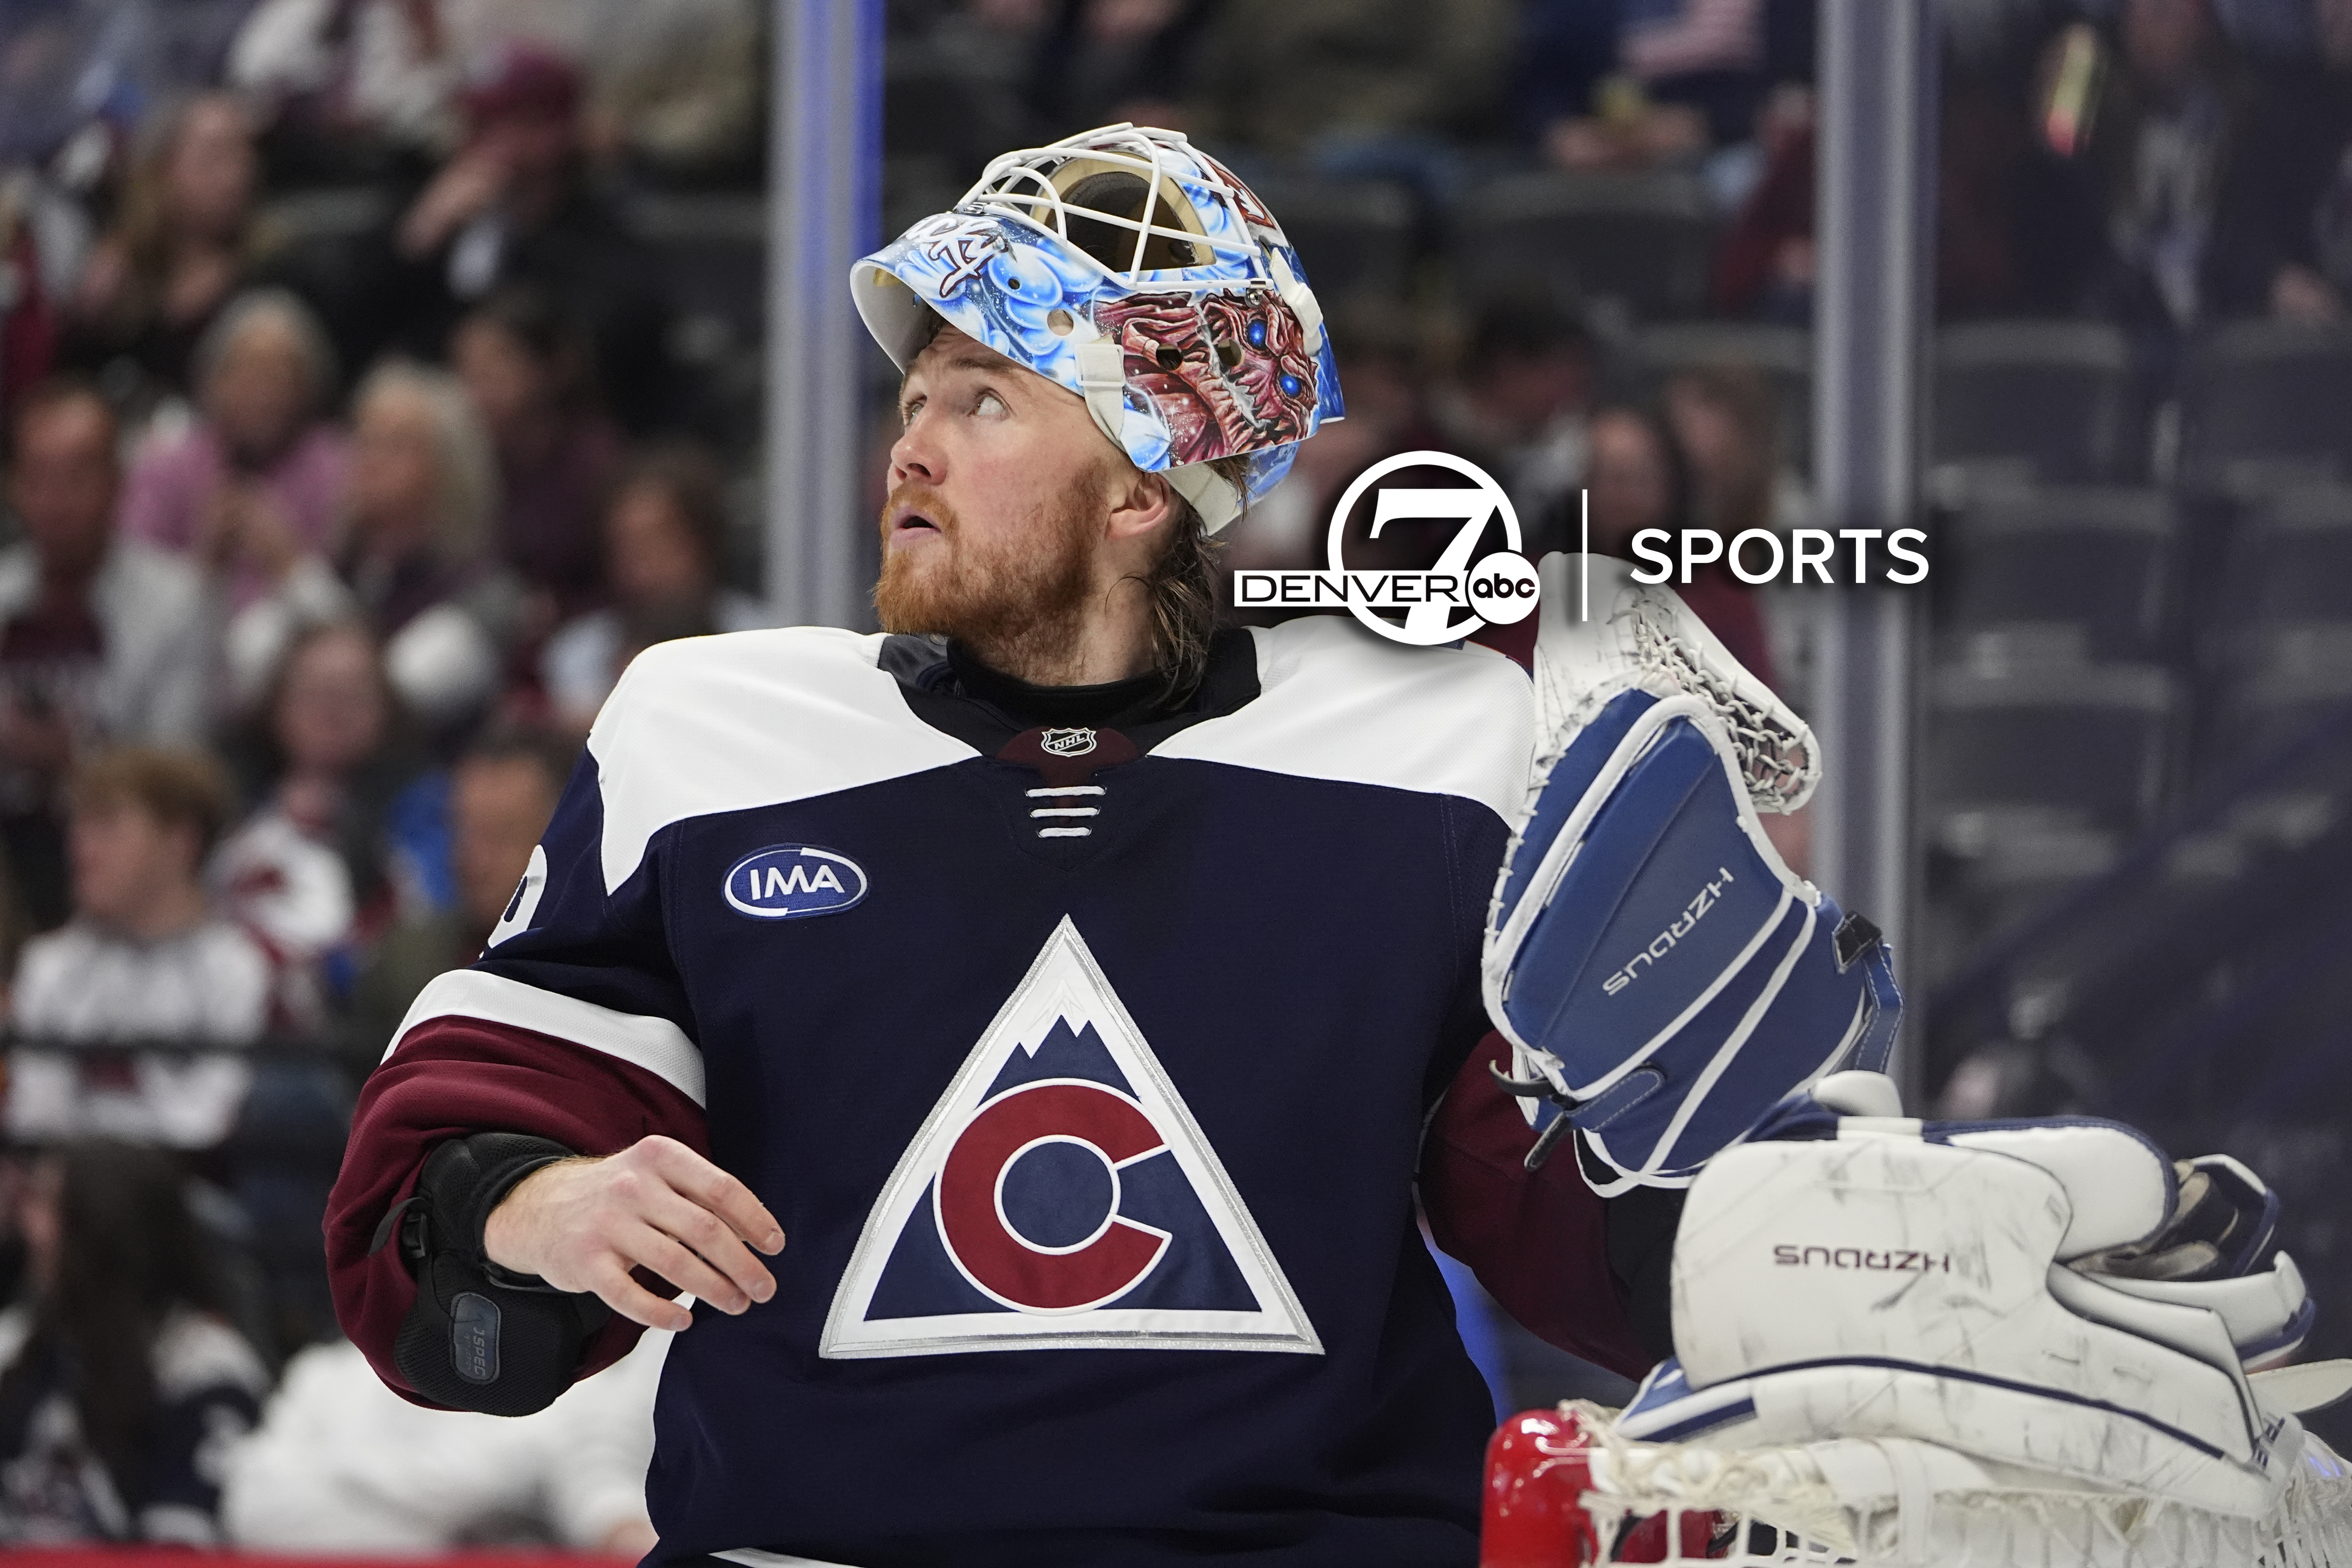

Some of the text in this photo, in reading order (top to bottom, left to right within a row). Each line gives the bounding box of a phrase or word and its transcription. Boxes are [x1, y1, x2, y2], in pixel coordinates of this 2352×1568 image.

[1054, 735, 1085, 750] NHL
[749, 864, 845, 900] IMA
[1602, 867, 1734, 997] HZRDUS
[933, 1077, 1173, 1316] C
[1773, 1244, 1950, 1273] HZRDUS
